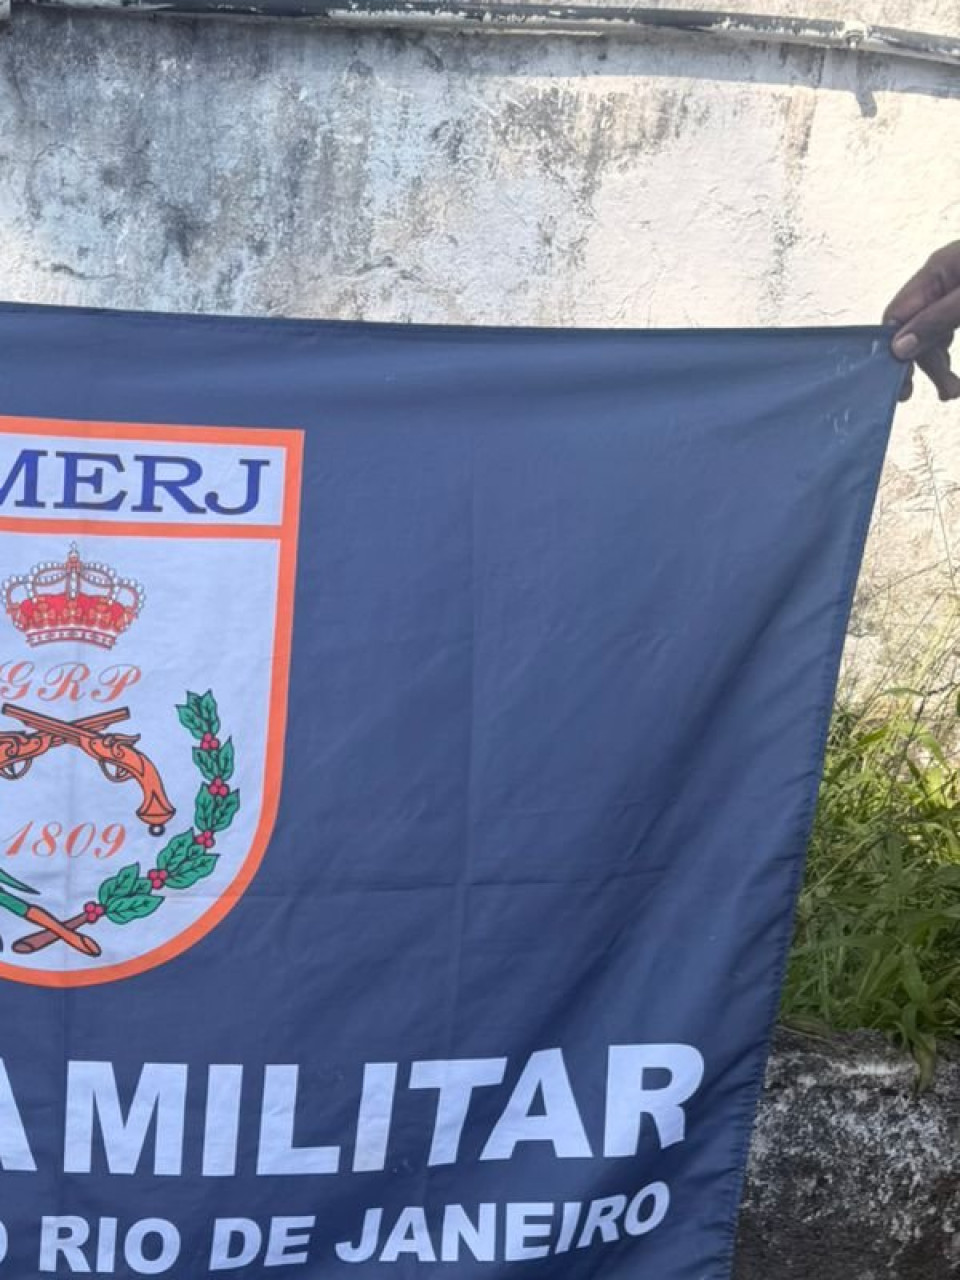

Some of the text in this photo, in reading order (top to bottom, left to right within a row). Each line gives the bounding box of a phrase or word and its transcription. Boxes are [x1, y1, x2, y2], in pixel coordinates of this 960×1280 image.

[4, 820, 127, 860] 1809
[63, 1042, 705, 1177] MILITAR
[38, 1214, 181, 1274] RIO
[209, 1214, 316, 1271] DE
[335, 1180, 671, 1262] JANEIRO
